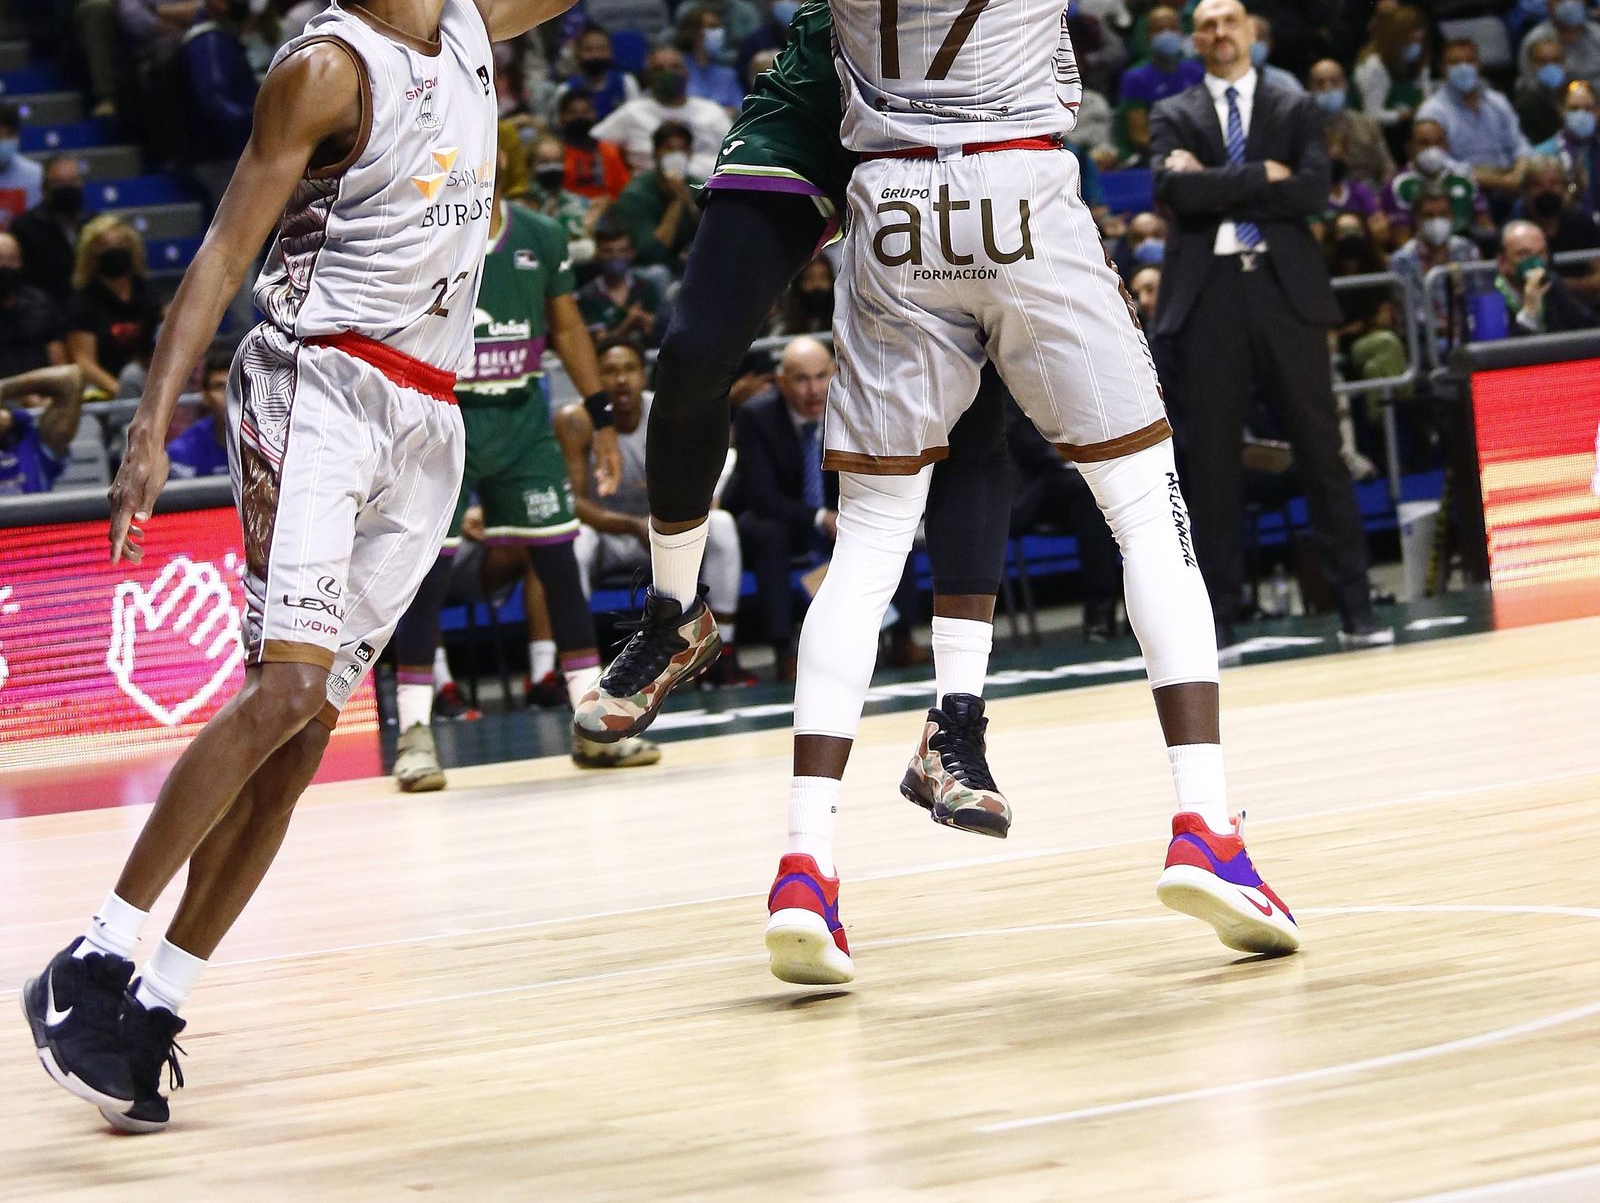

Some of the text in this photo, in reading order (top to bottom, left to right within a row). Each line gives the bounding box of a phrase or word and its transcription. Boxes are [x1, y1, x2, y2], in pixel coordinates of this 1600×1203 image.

[446, 169, 477, 187] SAN
[881, 187, 930, 200] GRUPO
[872, 183, 1035, 267] atu
[913, 266, 998, 281] FORMACIÓN
